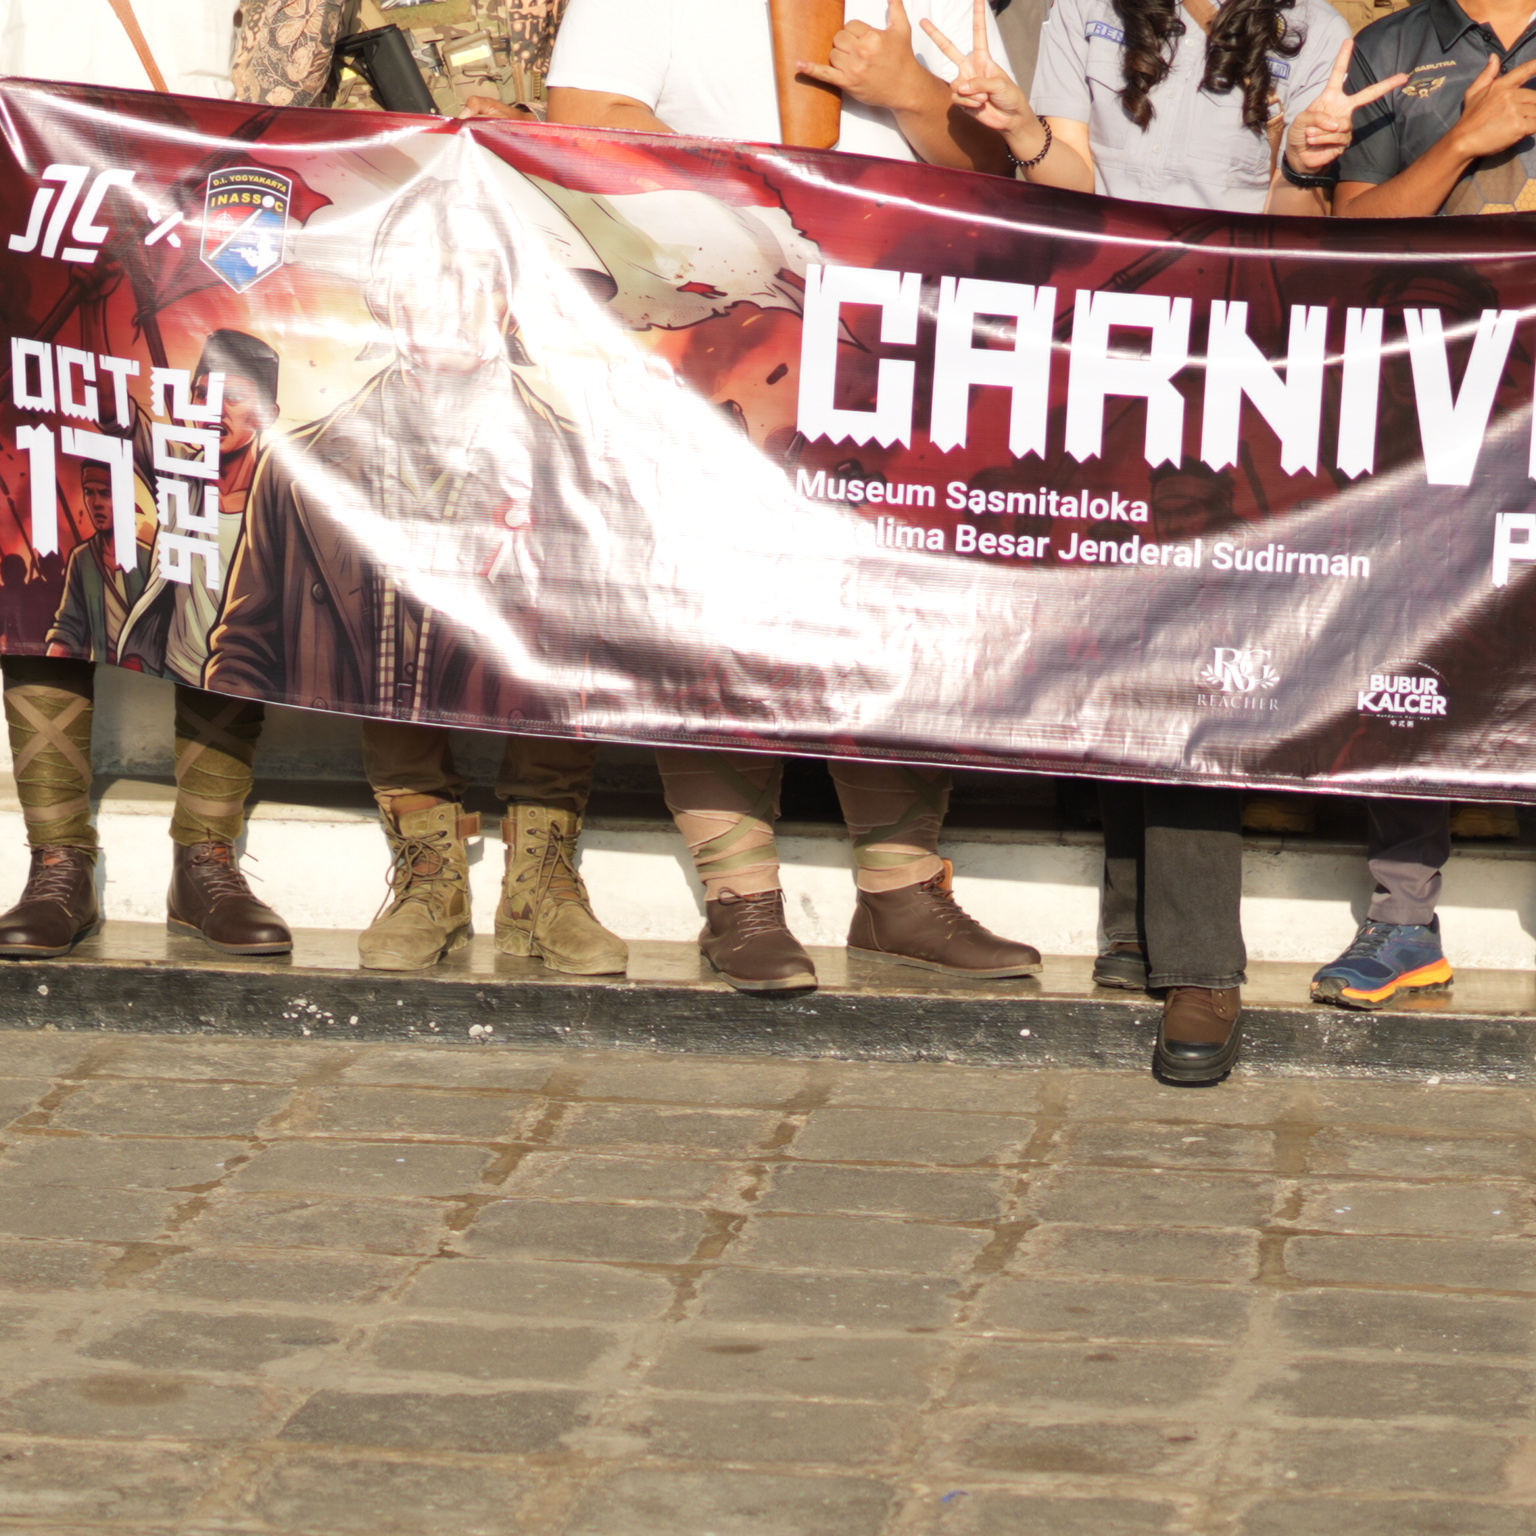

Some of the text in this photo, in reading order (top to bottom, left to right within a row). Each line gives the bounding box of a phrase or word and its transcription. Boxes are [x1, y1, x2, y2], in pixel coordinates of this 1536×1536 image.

[229, 173, 288, 193] YOGYAKARTA
[11, 337, 140, 429] OCT
[16, 423, 138, 574] 17
[795, 468, 1149, 523] Museum Sasmitaloka
[955, 523, 1050, 559] Besar
[1057, 532, 1202, 569] Jenderal
[1211, 539, 1370, 578] Sudirman
[1357, 690, 1448, 715] KALCER
[1370, 674, 1438, 695] BUBUR
